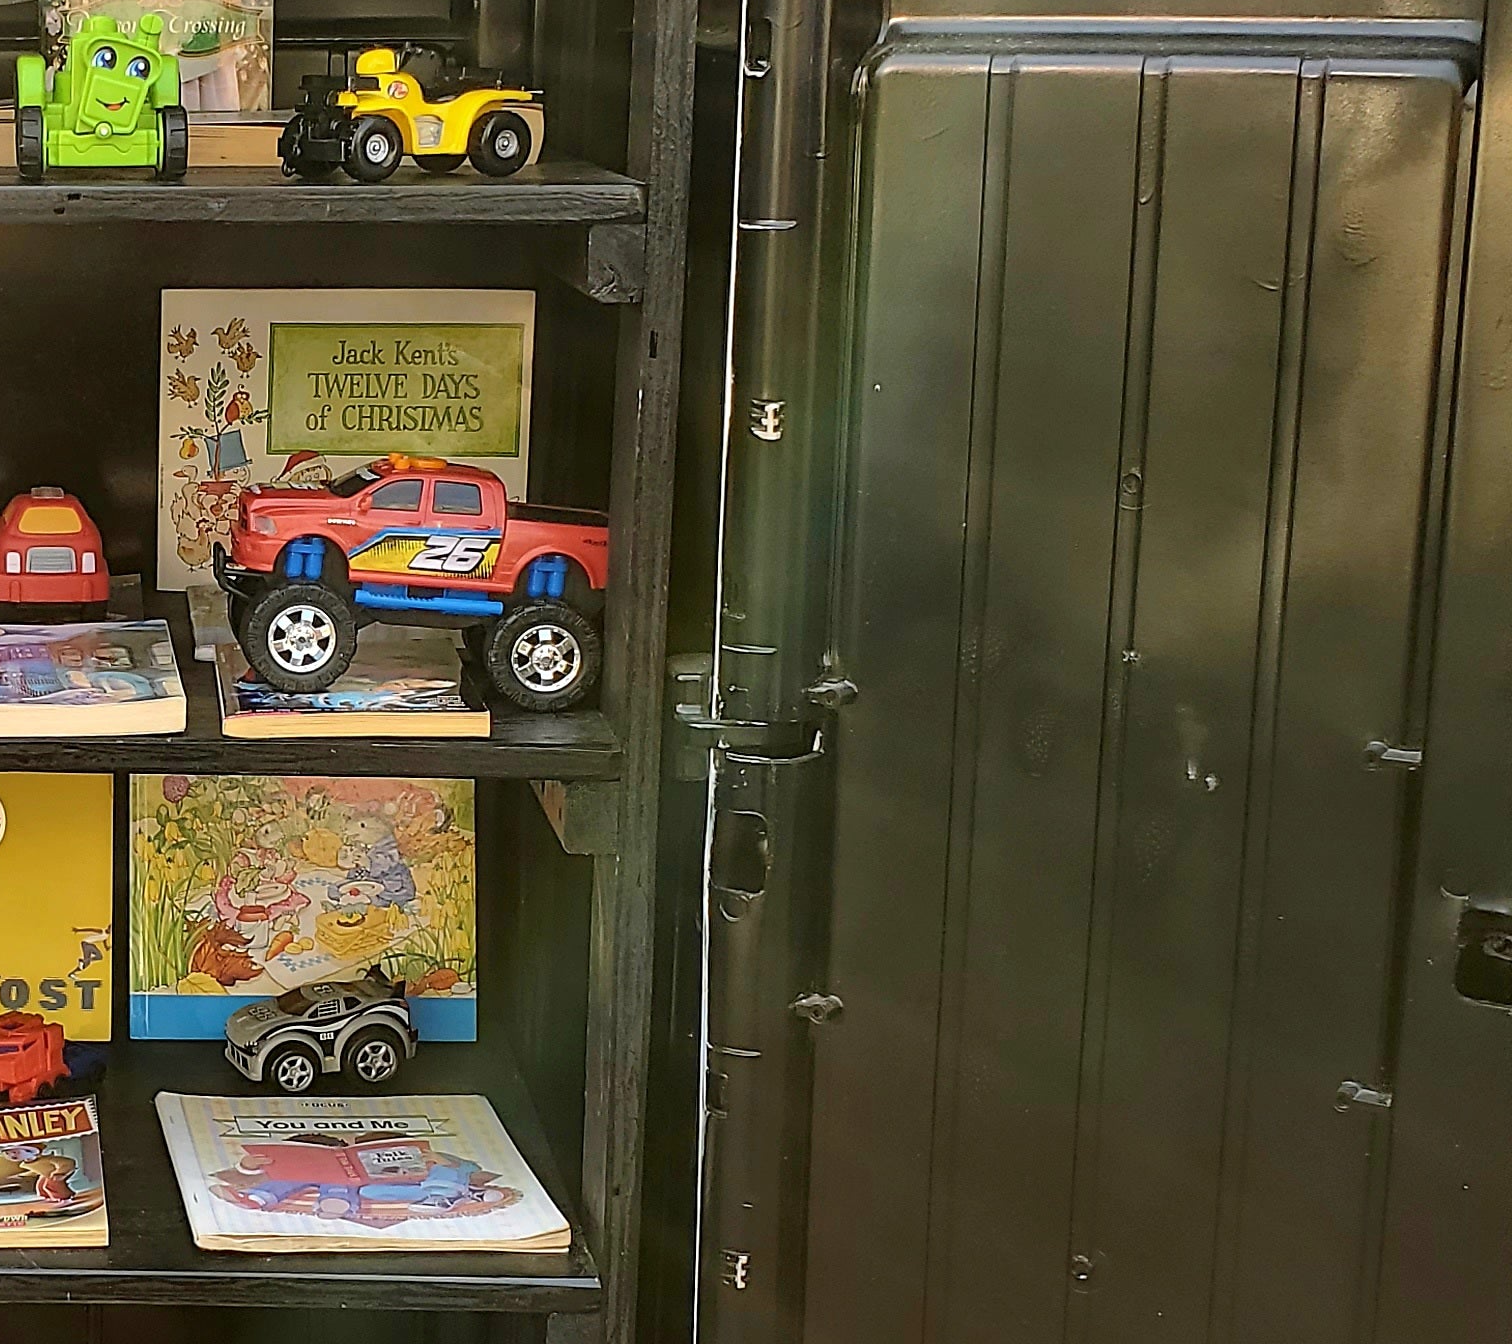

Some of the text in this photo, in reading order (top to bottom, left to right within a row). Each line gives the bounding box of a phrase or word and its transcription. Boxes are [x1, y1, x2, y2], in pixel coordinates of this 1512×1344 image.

[153, 10, 246, 40] Crossing
[332, 340, 459, 366] Jack Kent's
[307, 372, 480, 400] TWELVE DAYS
[305, 404, 484, 433] of CHRISTMAS
[408, 536, 490, 571] 26
[256, 1121, 306, 1129] You
[314, 1121, 360, 1129] and
